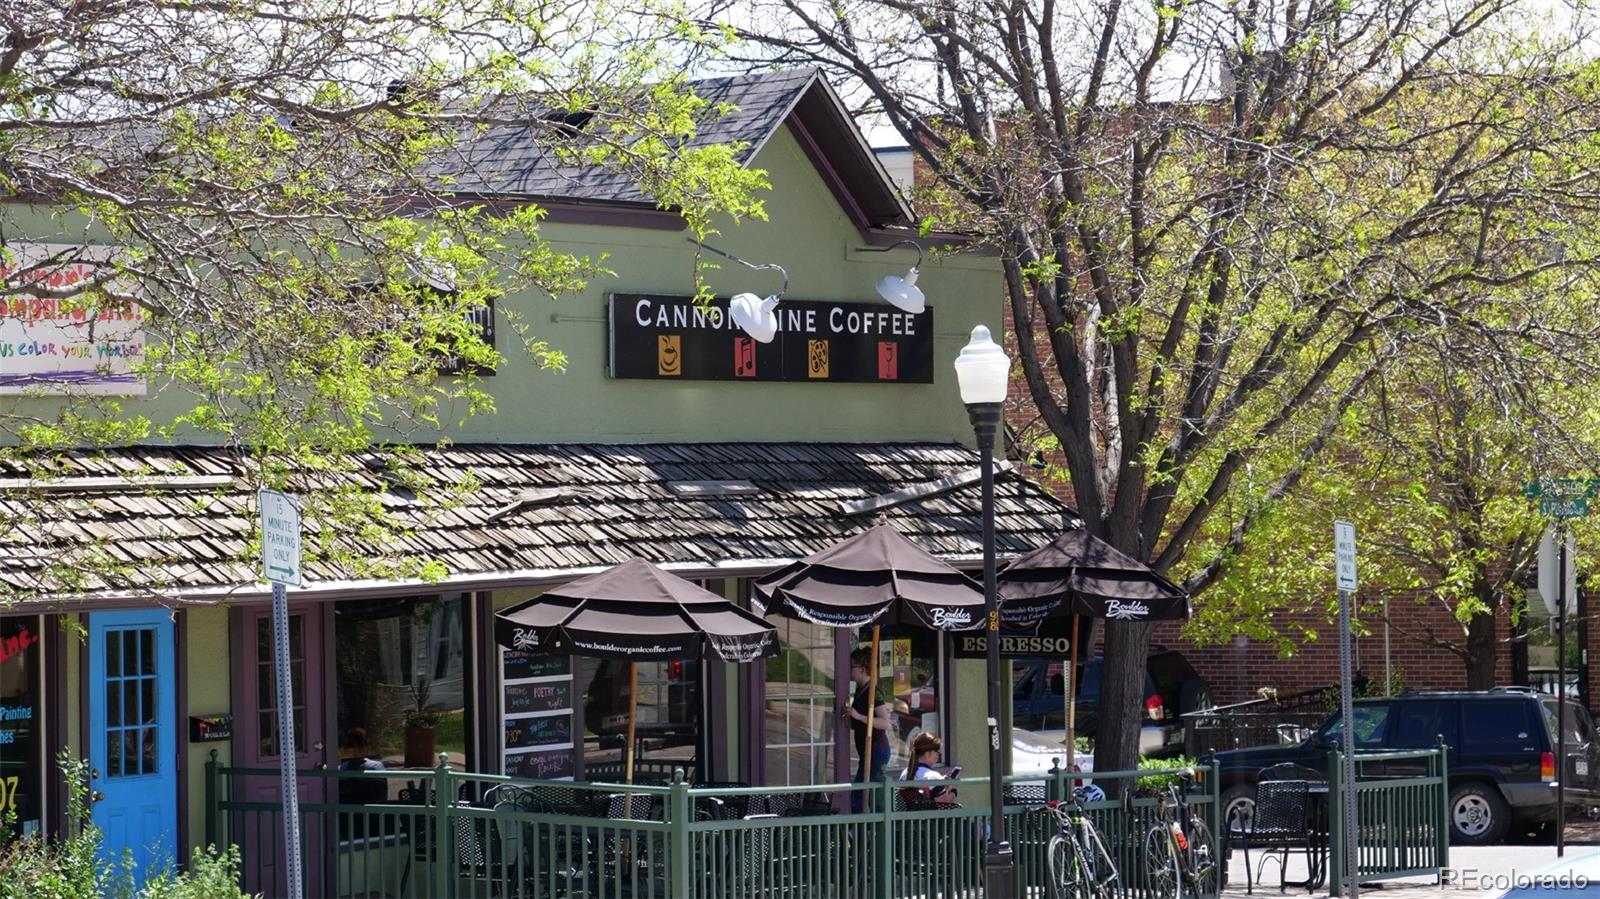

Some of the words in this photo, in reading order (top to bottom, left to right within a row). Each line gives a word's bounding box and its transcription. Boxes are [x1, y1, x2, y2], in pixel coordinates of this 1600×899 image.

[636, 299, 739, 330] CANNON
[830, 305, 915, 335] COFFEE
[267, 517, 292, 533] MINUTE
[267, 532, 296, 548] PARKING
[273, 548, 290, 562] ONLY
[962, 637, 1070, 653] ESRESSO
